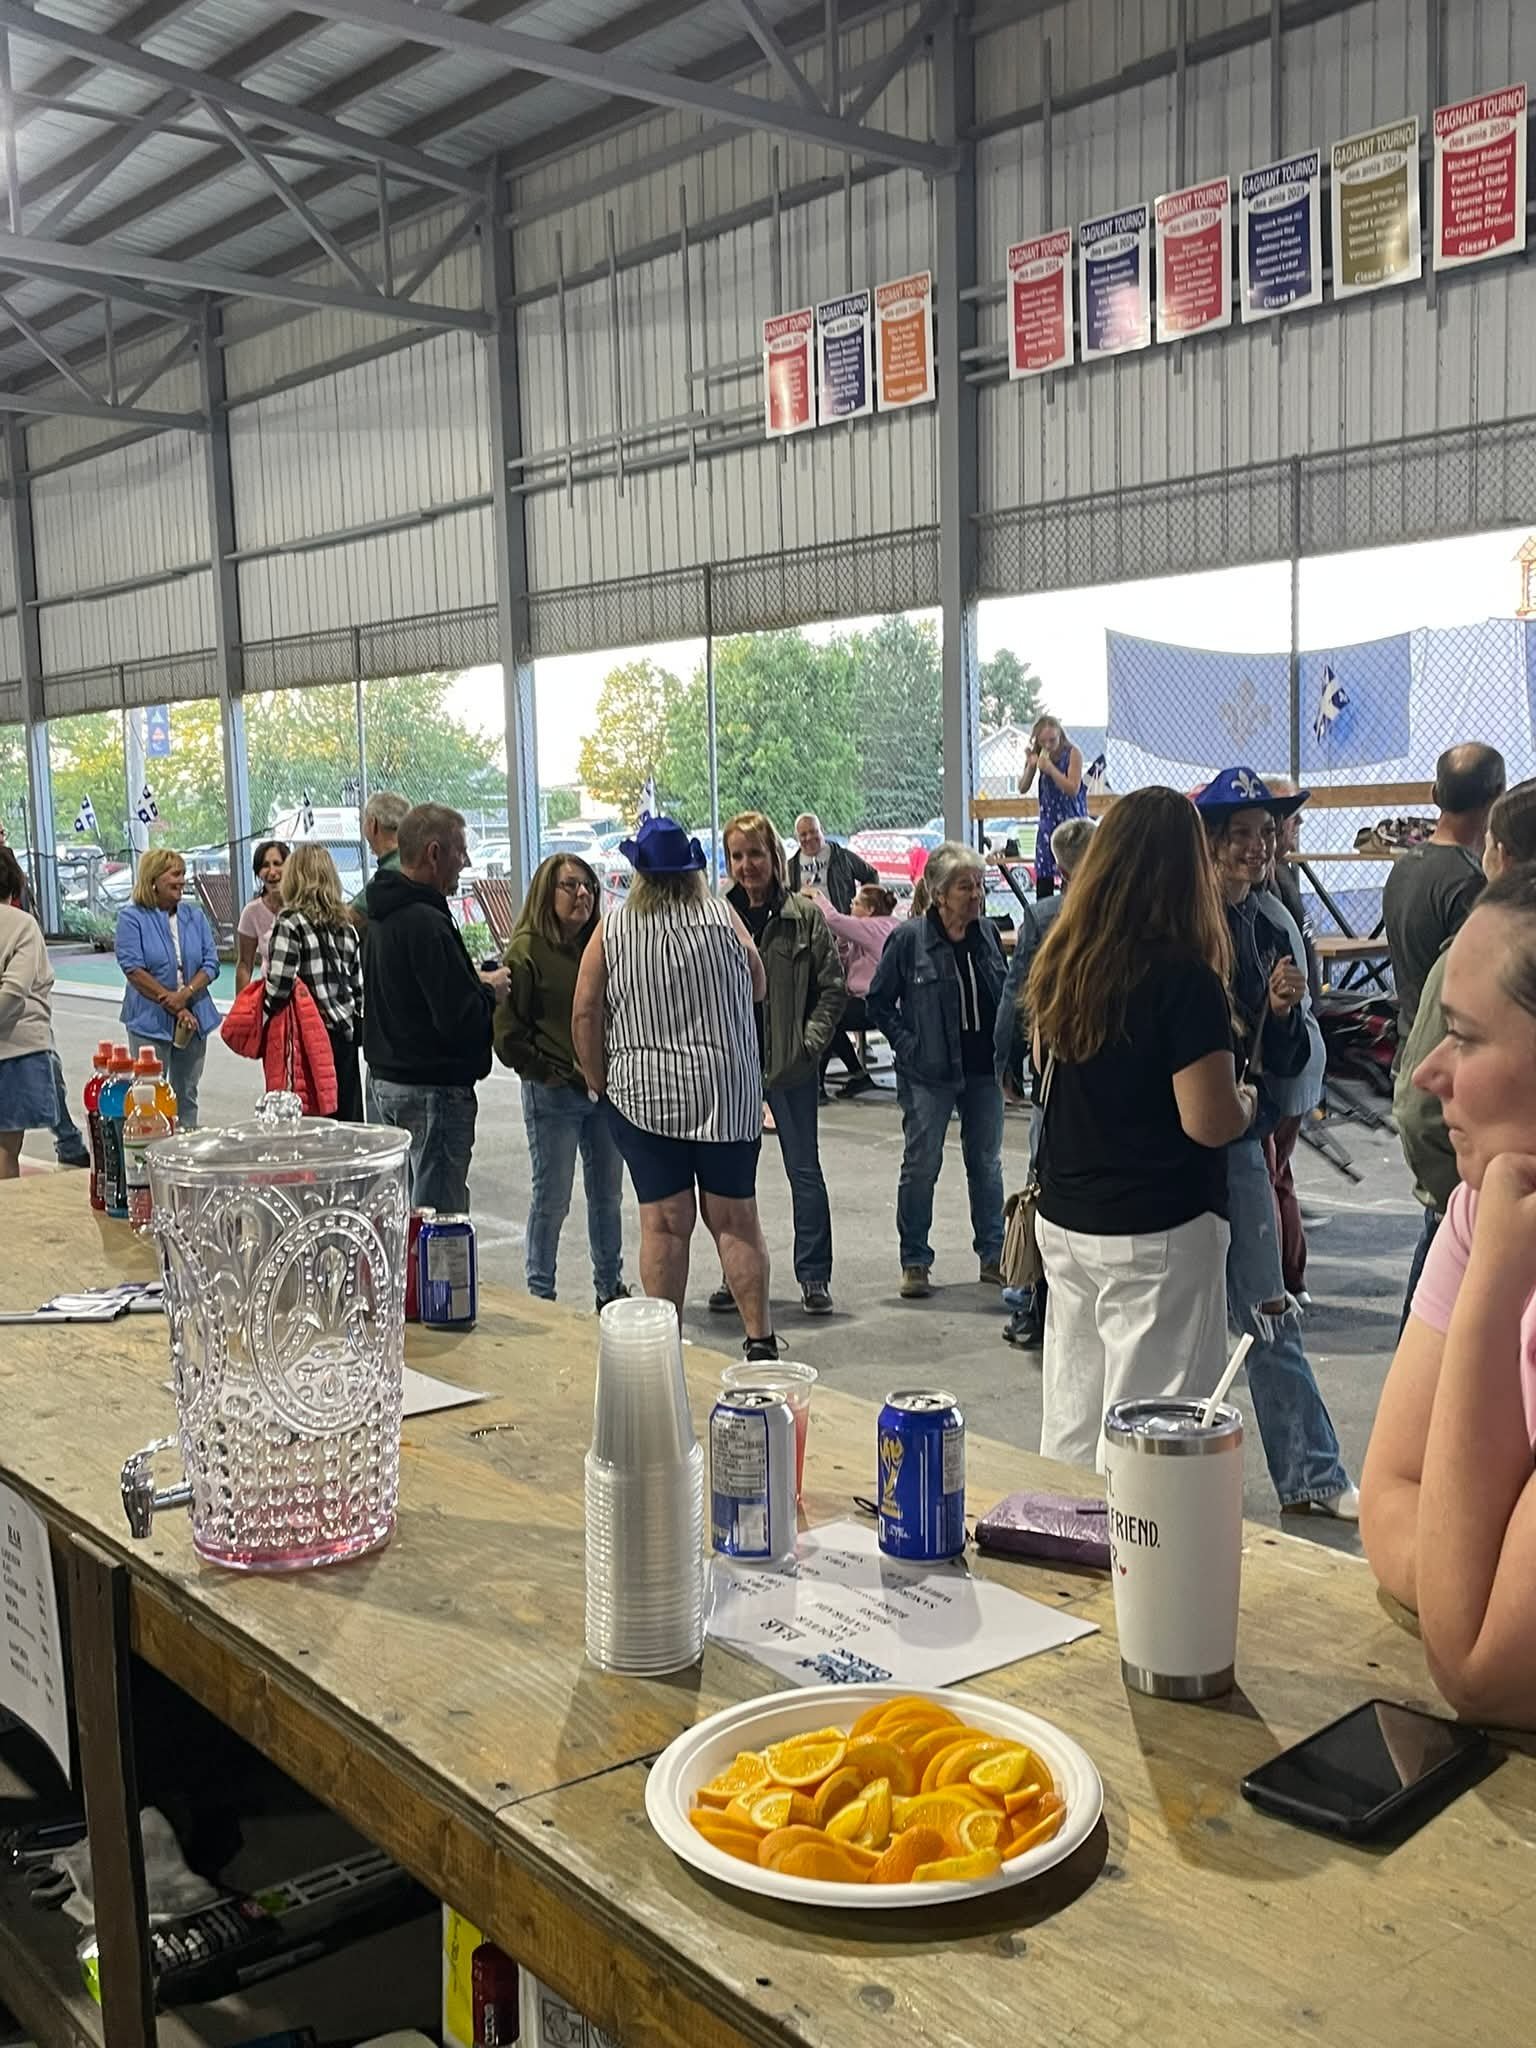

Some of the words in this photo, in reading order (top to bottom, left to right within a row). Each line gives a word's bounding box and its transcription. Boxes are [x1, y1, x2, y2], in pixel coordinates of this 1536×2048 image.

[1436, 105, 1479, 133] GAGNANT
[1482, 88, 1524, 116] TOURNOI
[1335, 137, 1375, 166] GAGNANT
[1377, 122, 1414, 151] TOURNOI
[1450, 134, 1464, 147] des
[1467, 129, 1487, 145] amis
[1243, 172, 1280, 197] GAGNANT
[1281, 157, 1317, 182] TOURNOI
[1451, 179, 1483, 197] Yannick
[1158, 195, 1194, 221] GAGNANT
[1195, 184, 1227, 207] TOURNOI
[1081, 220, 1113, 244] GAGNANT
[1114, 209, 1145, 233] TOURNOI
[1009, 244, 1040, 267] GAGNANT
[1041, 234, 1069, 257] TOURNOI
[1459, 238, 1488, 255] Classe
[1490, 234, 1496, 247] A
[1355, 269, 1381, 284] Classe
[1264, 293, 1289, 308] Classe
[1111, 1507, 1161, 1549] FRIEND.
[760, 1618, 800, 1641] BAR
